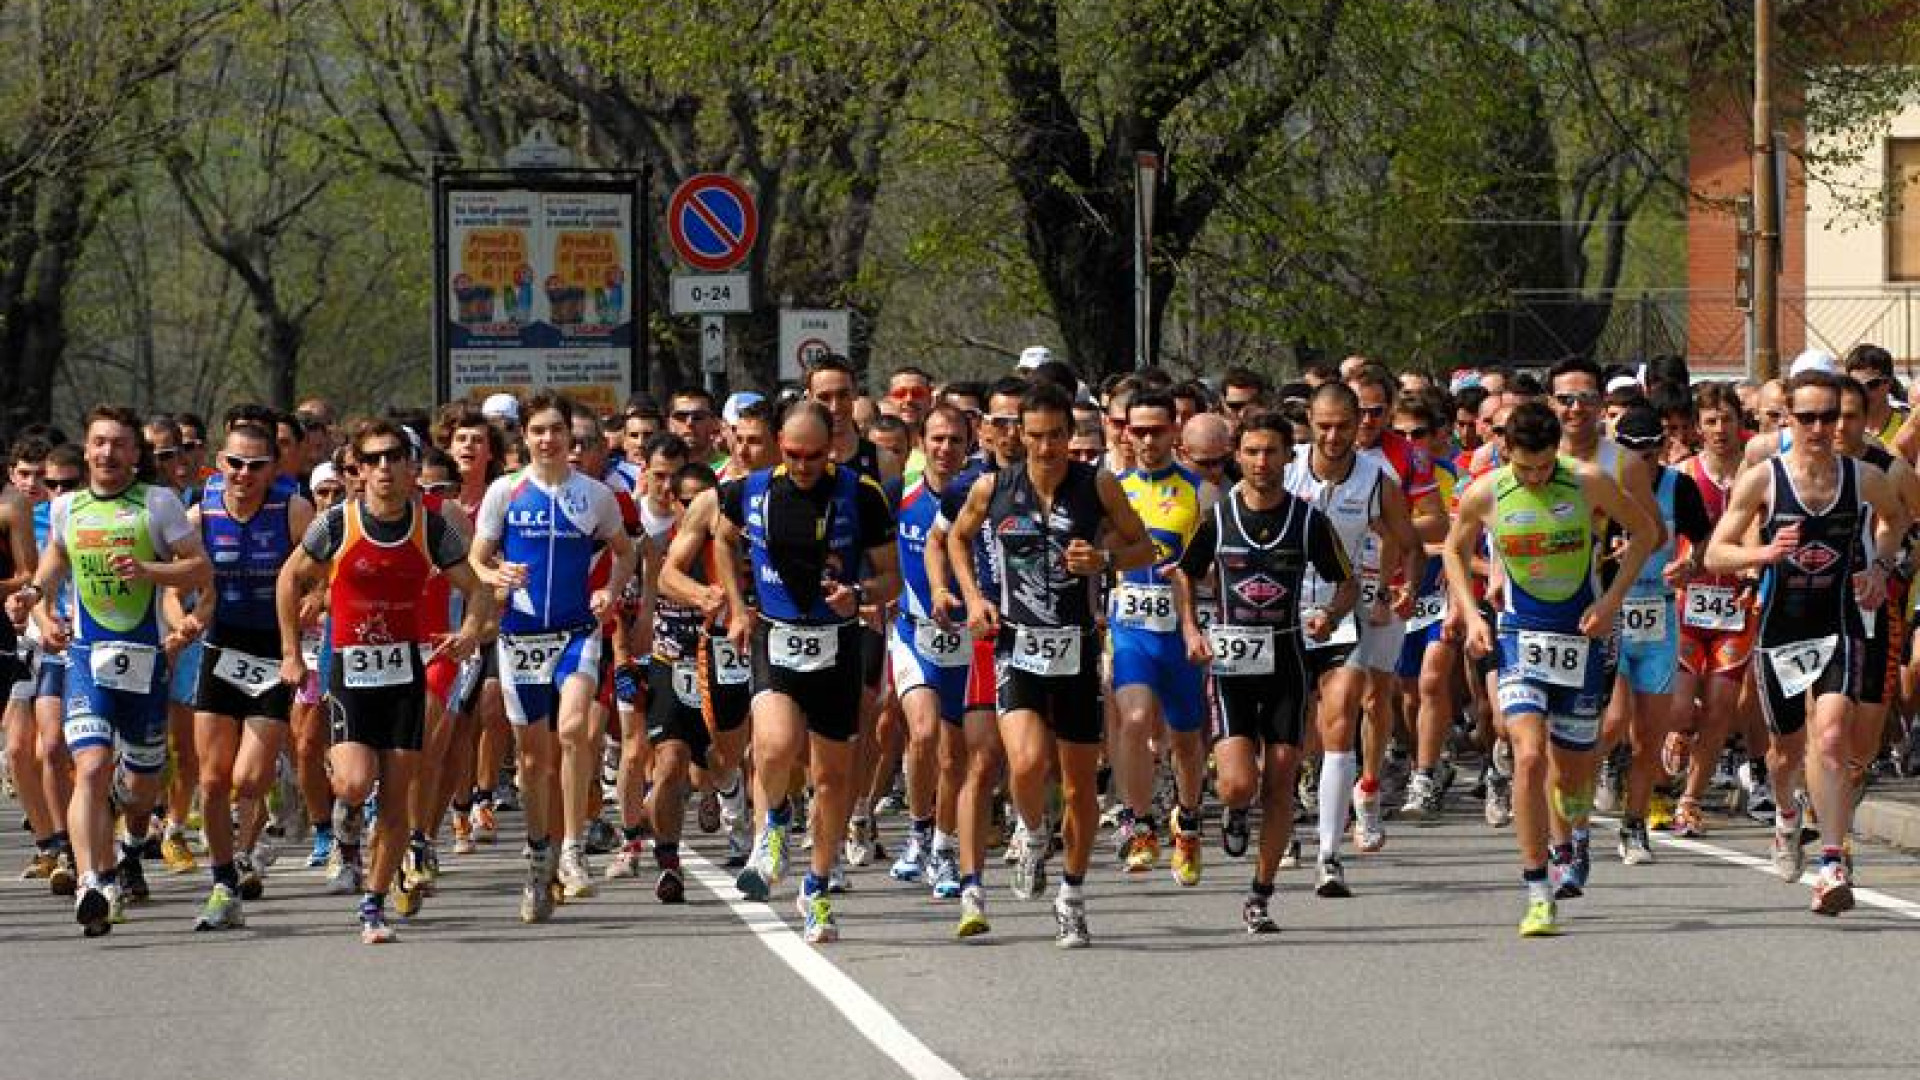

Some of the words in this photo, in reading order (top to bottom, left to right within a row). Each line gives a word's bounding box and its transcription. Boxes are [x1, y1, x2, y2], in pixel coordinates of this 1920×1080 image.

[690, 285, 731, 301] 0-24
[90, 580, 131, 597] ITA
[1125, 594, 1170, 618] 348
[1693, 593, 1738, 618] 345
[786, 635, 822, 656] 98
[930, 630, 961, 654] 49
[1023, 632, 1073, 660] 357
[1216, 637, 1266, 661] 397
[114, 652, 130, 675] 9
[352, 647, 404, 673] 314
[1528, 642, 1578, 671] 318
[1791, 648, 1821, 676] 12
[232, 659, 267, 685] 35
